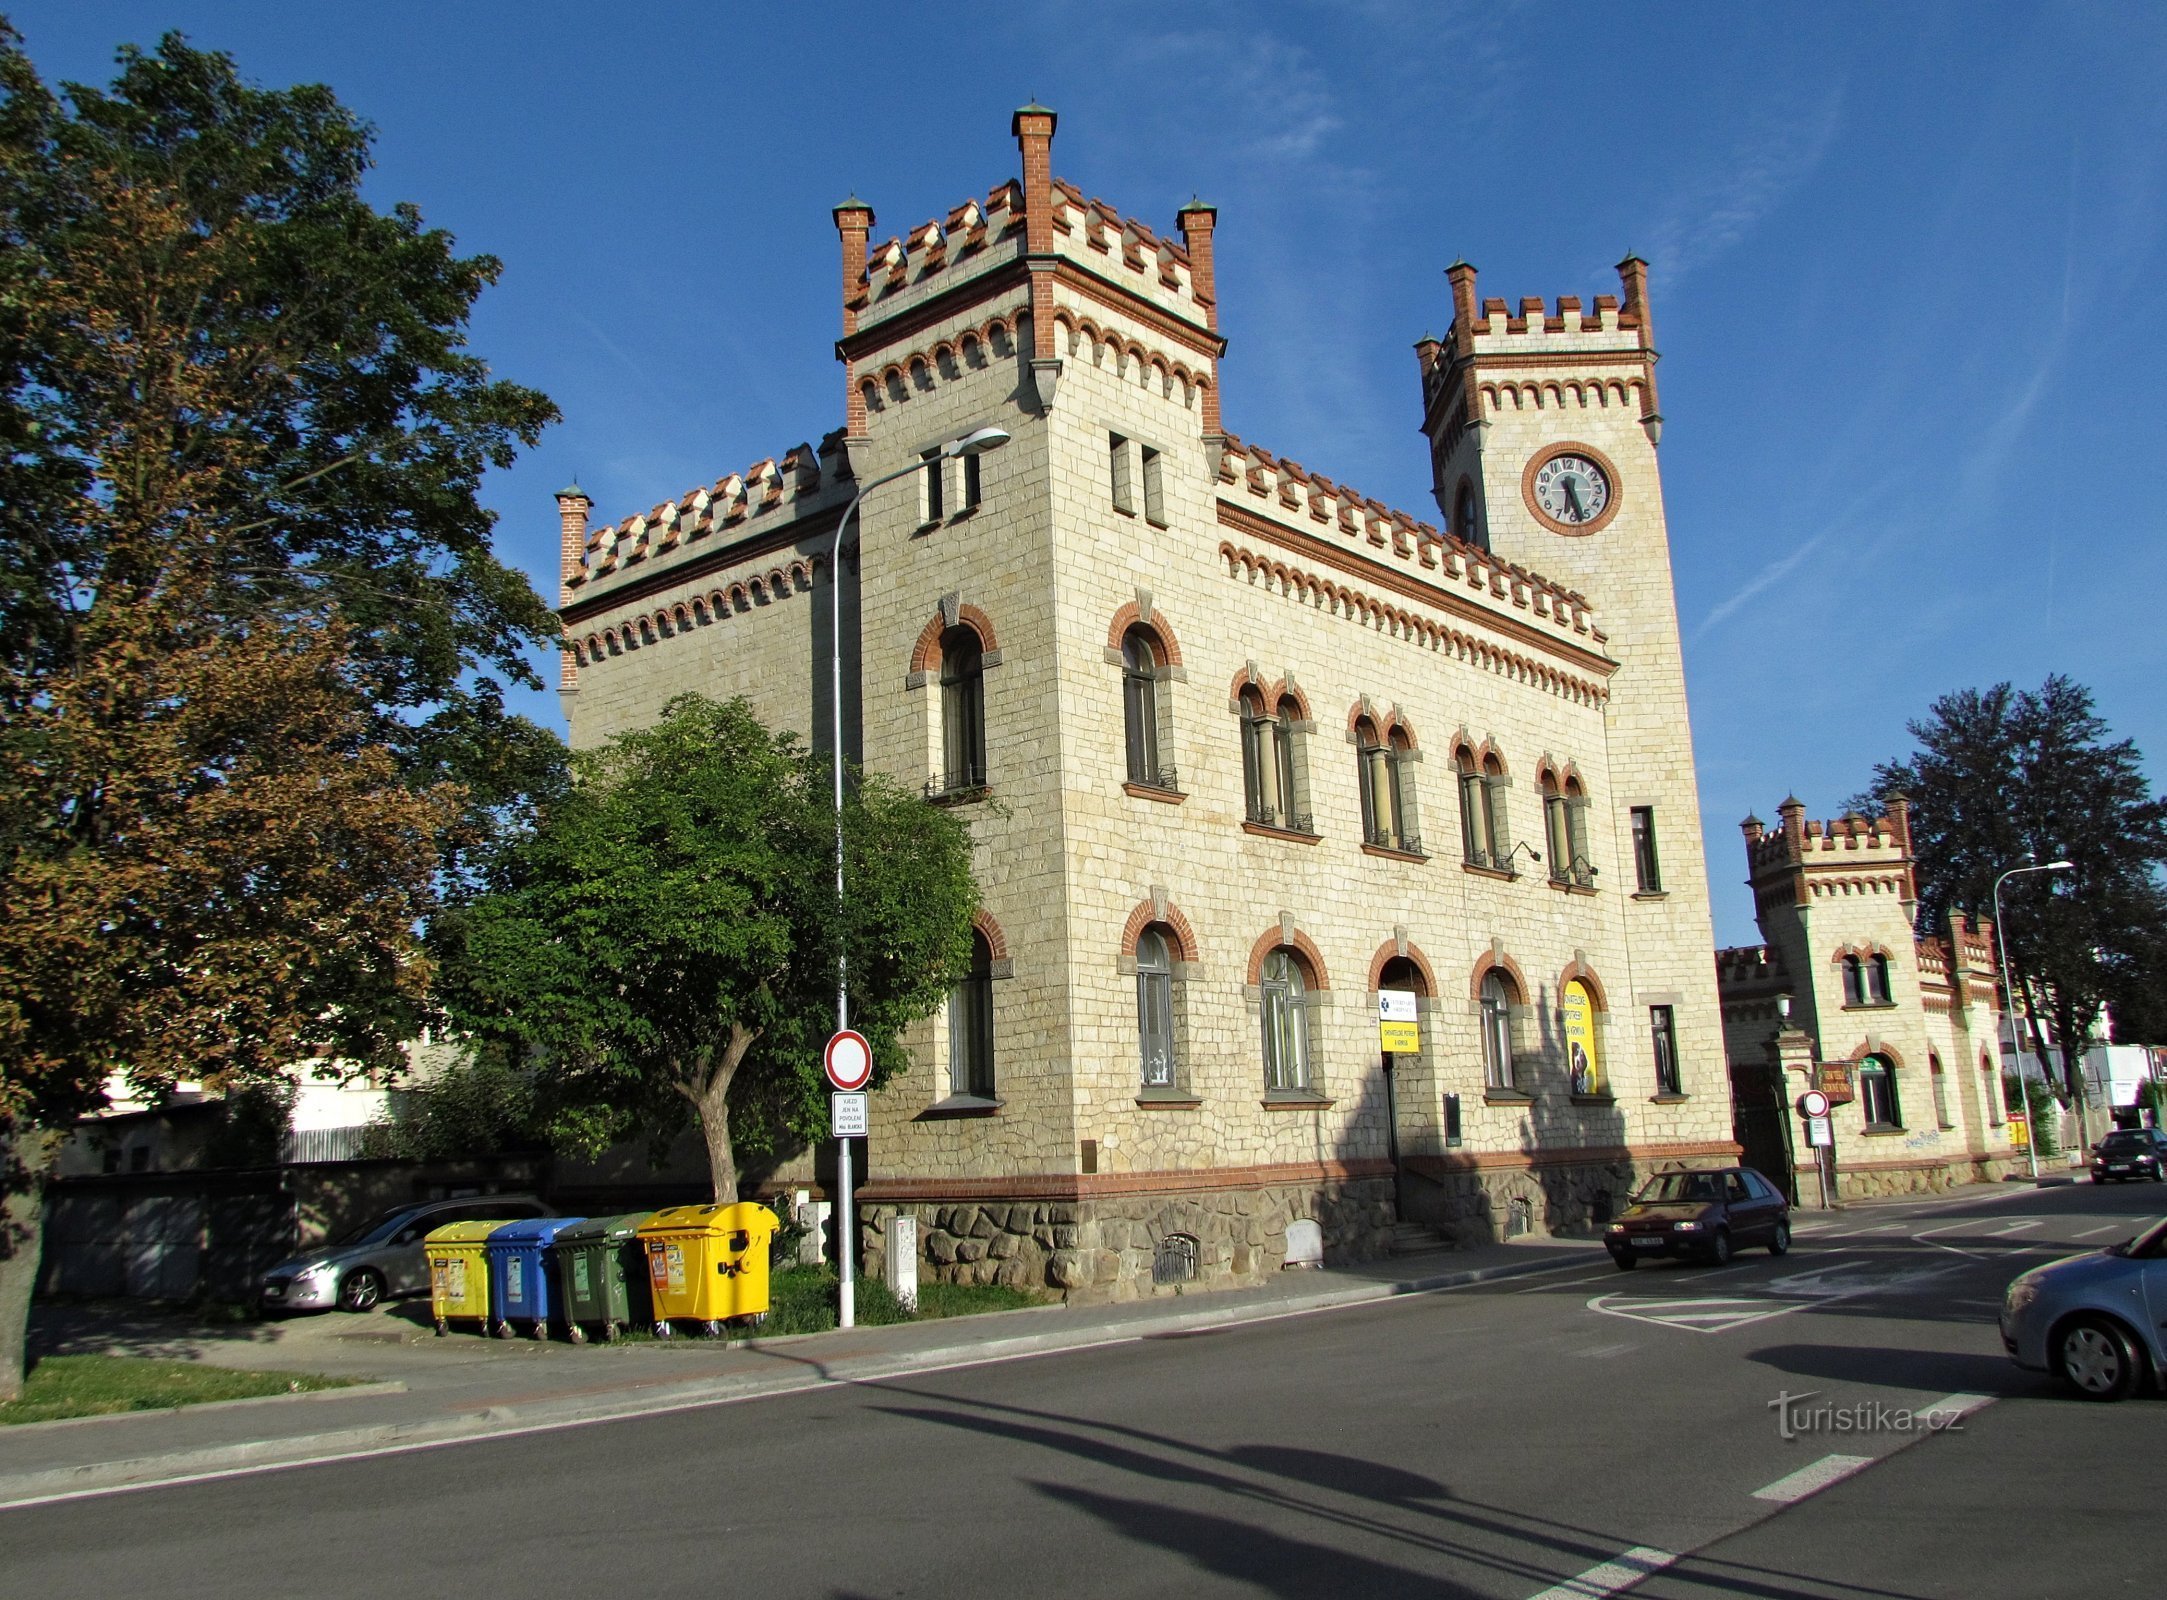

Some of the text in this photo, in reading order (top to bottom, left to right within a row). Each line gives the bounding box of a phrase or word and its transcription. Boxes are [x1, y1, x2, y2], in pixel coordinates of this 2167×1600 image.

[1549, 463, 1558, 473] 11
[1562, 459, 1573, 470] 12
[1579, 462, 1585, 471] 1
[1540, 472, 1550, 482] 10
[1589, 471, 1598, 481] 2
[1538, 486, 1547, 496] 9
[1594, 485, 1603, 495] 3
[1544, 500, 1552, 510] 8
[1591, 498, 1600, 508] 4
[1555, 509, 1563, 519] 7
[1582, 509, 1591, 519] 5
